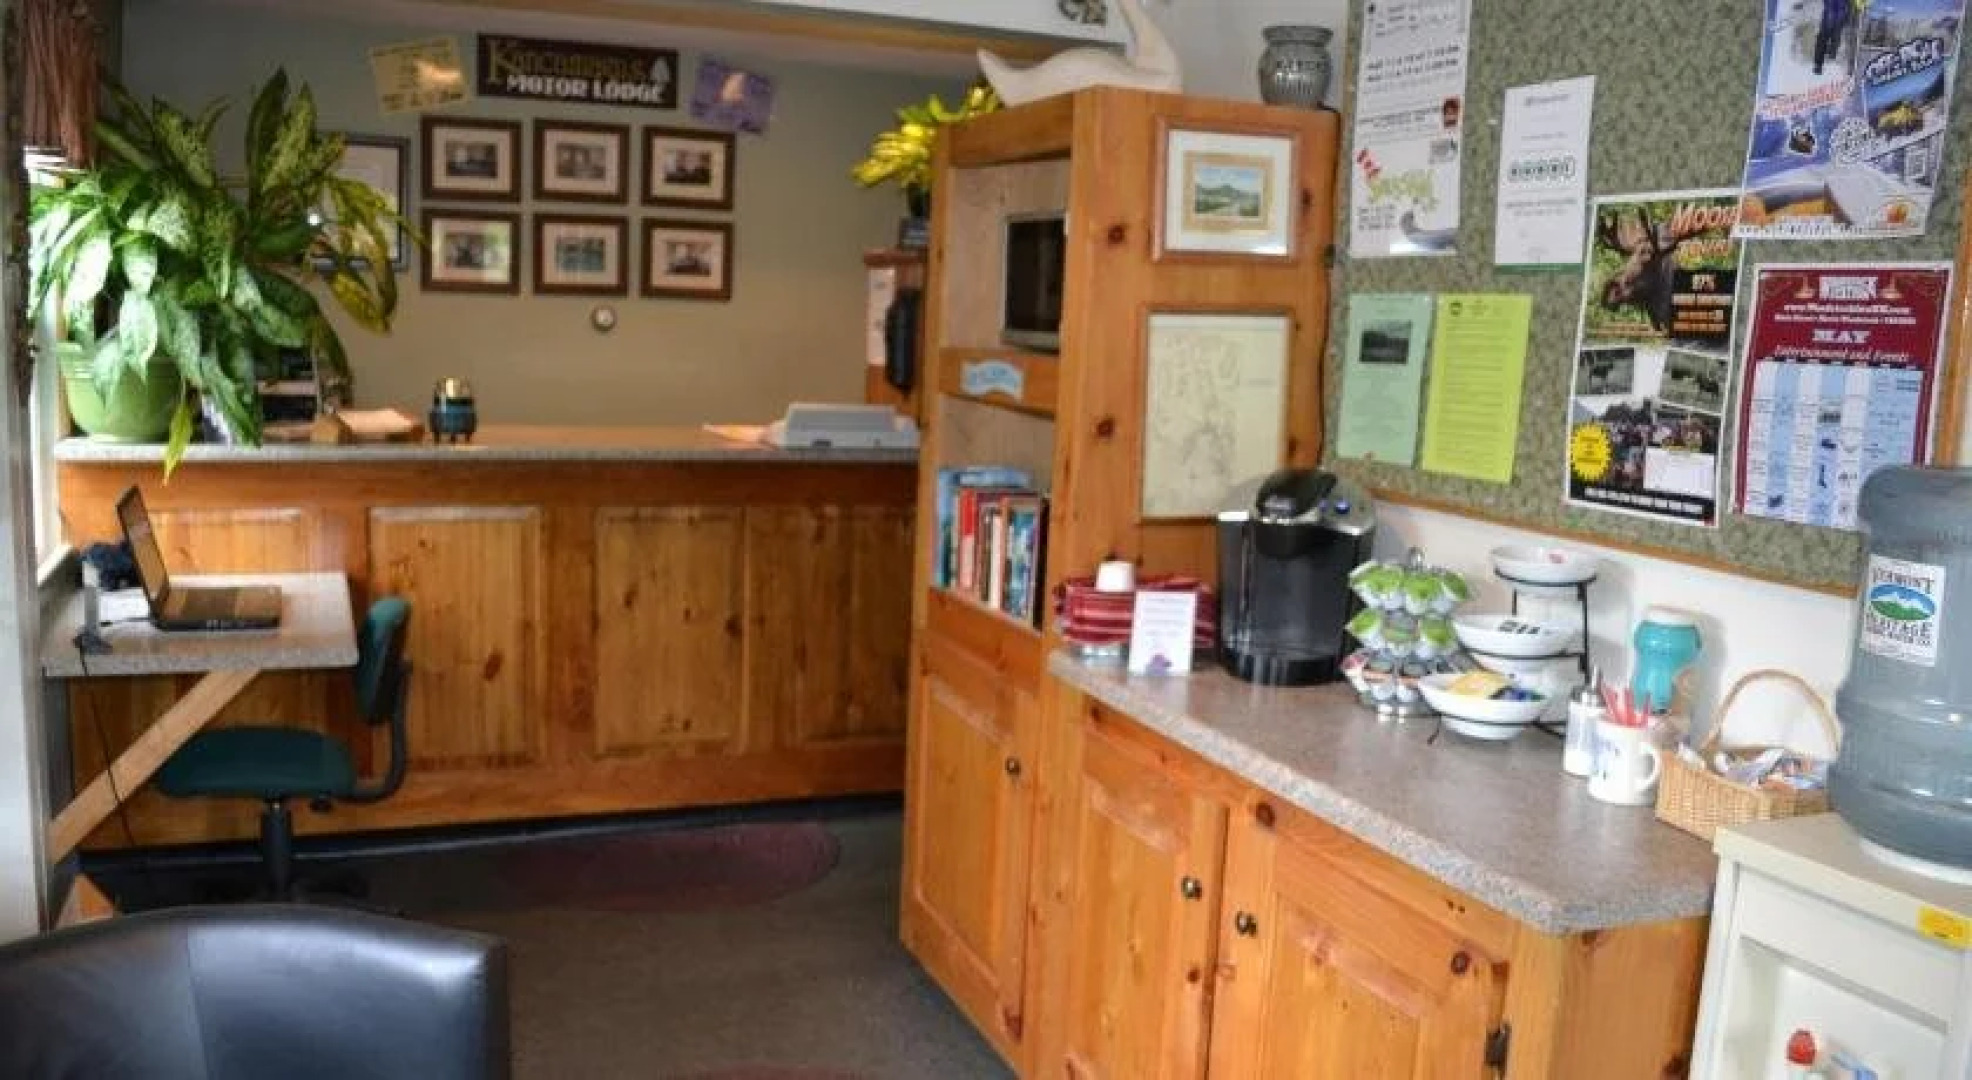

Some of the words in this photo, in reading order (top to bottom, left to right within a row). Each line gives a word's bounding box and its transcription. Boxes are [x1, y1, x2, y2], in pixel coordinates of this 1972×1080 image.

[507, 75, 588, 98] MOTOR
[593, 80, 662, 103] LODGE
[1812, 329, 1871, 344] MAY
